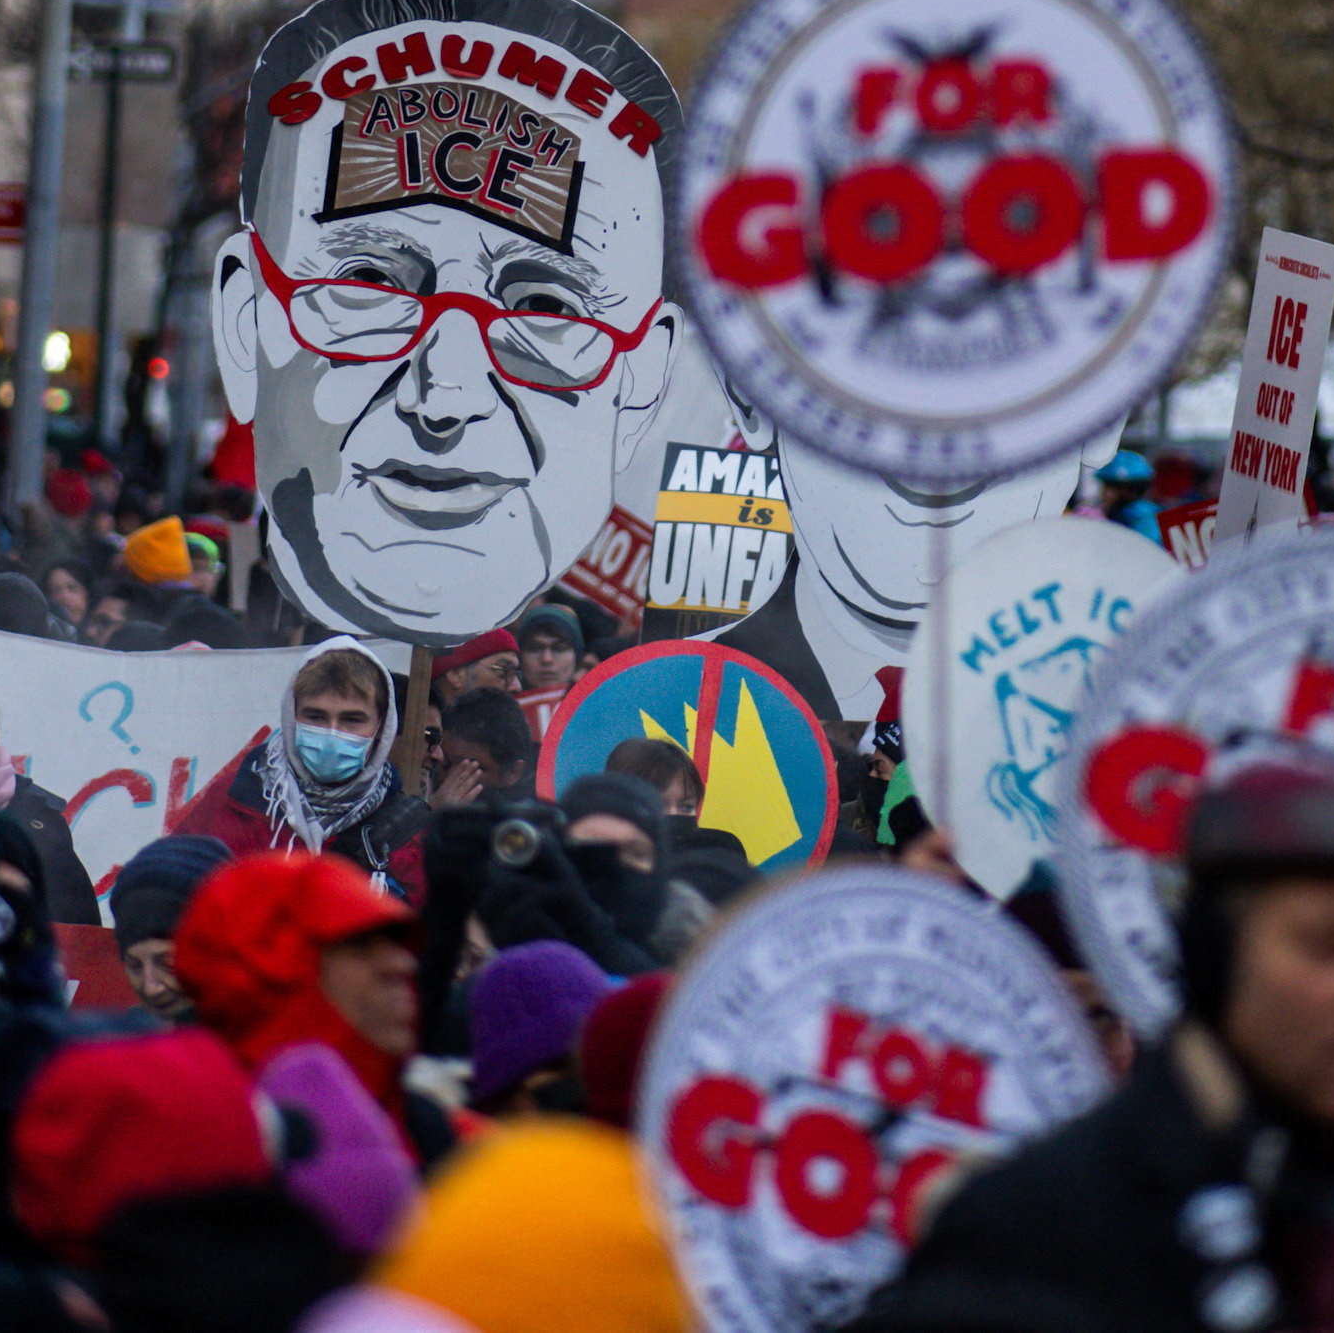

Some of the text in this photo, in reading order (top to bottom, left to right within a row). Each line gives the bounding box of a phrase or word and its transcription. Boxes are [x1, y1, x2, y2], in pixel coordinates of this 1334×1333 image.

[267, 31, 663, 159] SCHUMER
[359, 86, 571, 167] ABOLISH
[853, 56, 1056, 138] FOR
[397, 129, 537, 214] ICE
[697, 148, 1213, 292] GOOD
[1266, 294, 1309, 371] ICE
[1255, 381, 1296, 427] OUT OF
[1229, 429, 1302, 496] NEW YORK
[737, 498, 775, 526] is
[959, 580, 1063, 674] MELT
[821, 1003, 991, 1130] FOR
